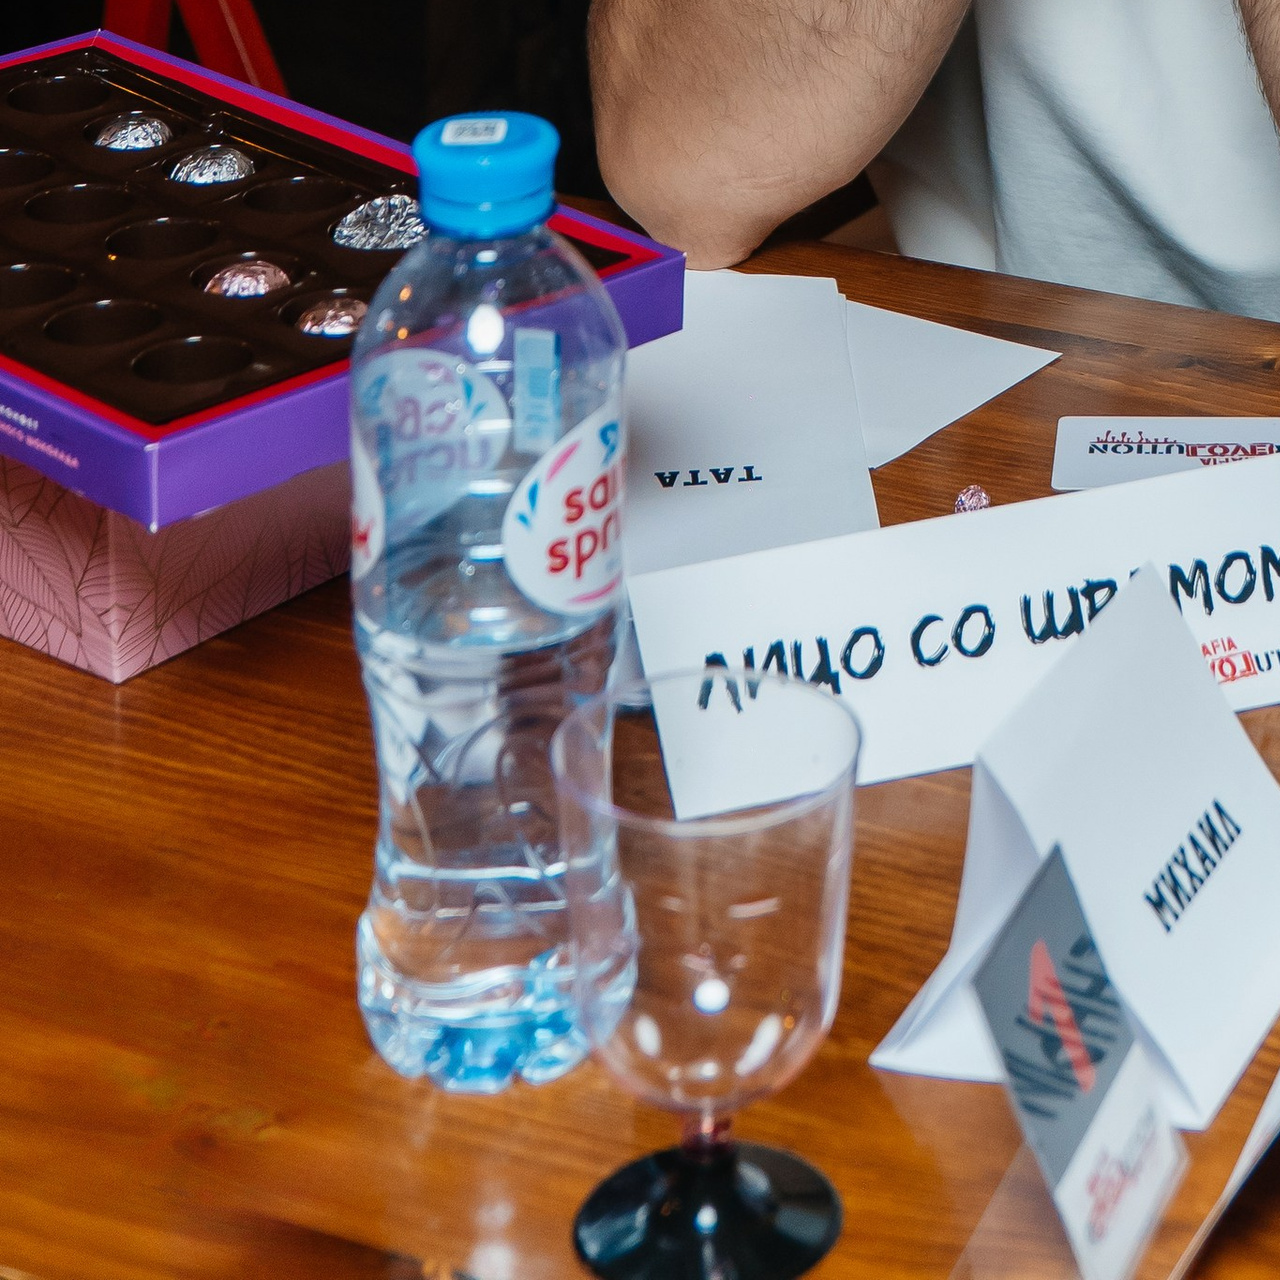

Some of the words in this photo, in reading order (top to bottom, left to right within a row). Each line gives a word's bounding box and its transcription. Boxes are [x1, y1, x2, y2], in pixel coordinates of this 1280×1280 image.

[697, 625, 886, 715] ЛИЦО
[909, 603, 996, 667] СО
[1200, 635, 1238, 658] AFIA
[1143, 797, 1243, 933] МИХАИЛ
